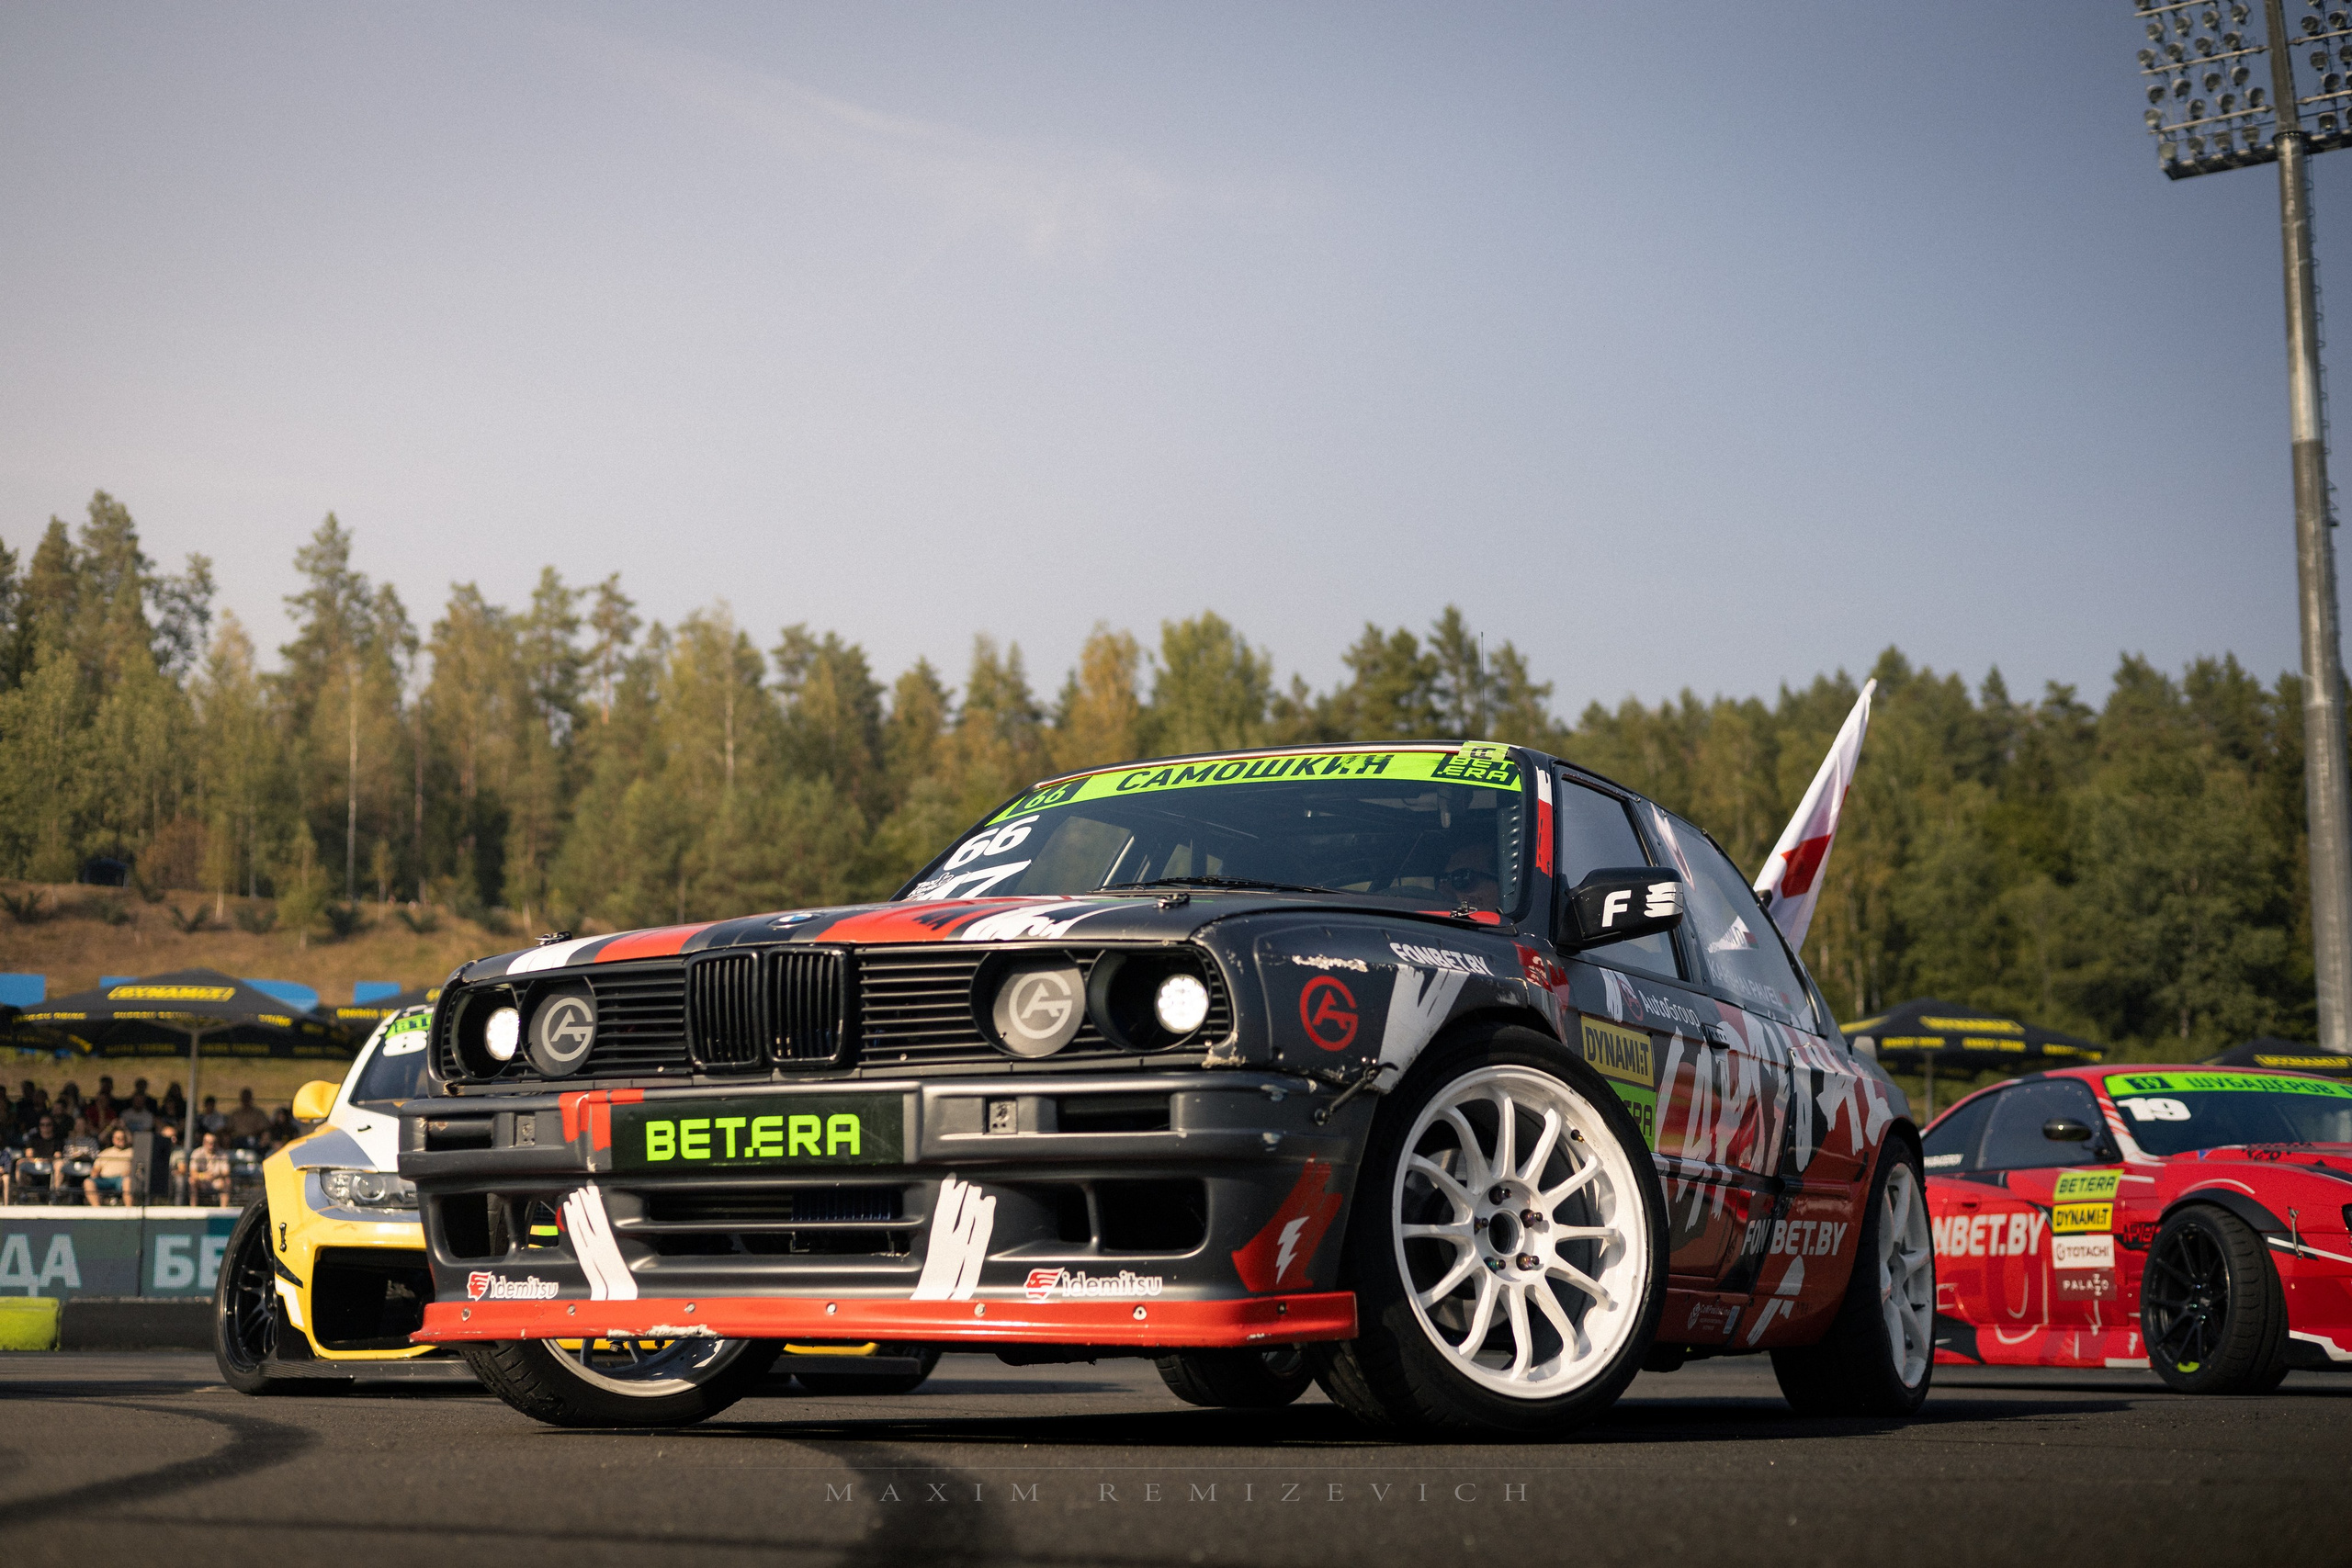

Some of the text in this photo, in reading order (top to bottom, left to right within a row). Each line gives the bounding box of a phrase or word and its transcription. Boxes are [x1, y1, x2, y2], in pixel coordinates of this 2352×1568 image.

[1115, 754, 1394, 792] САМОШКИН
[1023, 784, 1071, 809] 66
[943, 814, 1040, 871] 66
[1637, 989, 1701, 1033] AutoGroup
[2116, 1097, 2192, 1122] 19
[2067, 1246, 2110, 1258] TOTACHI
[491, 1274, 559, 1301] idemitsu
[1062, 1270, 1162, 1298] idemitsu
